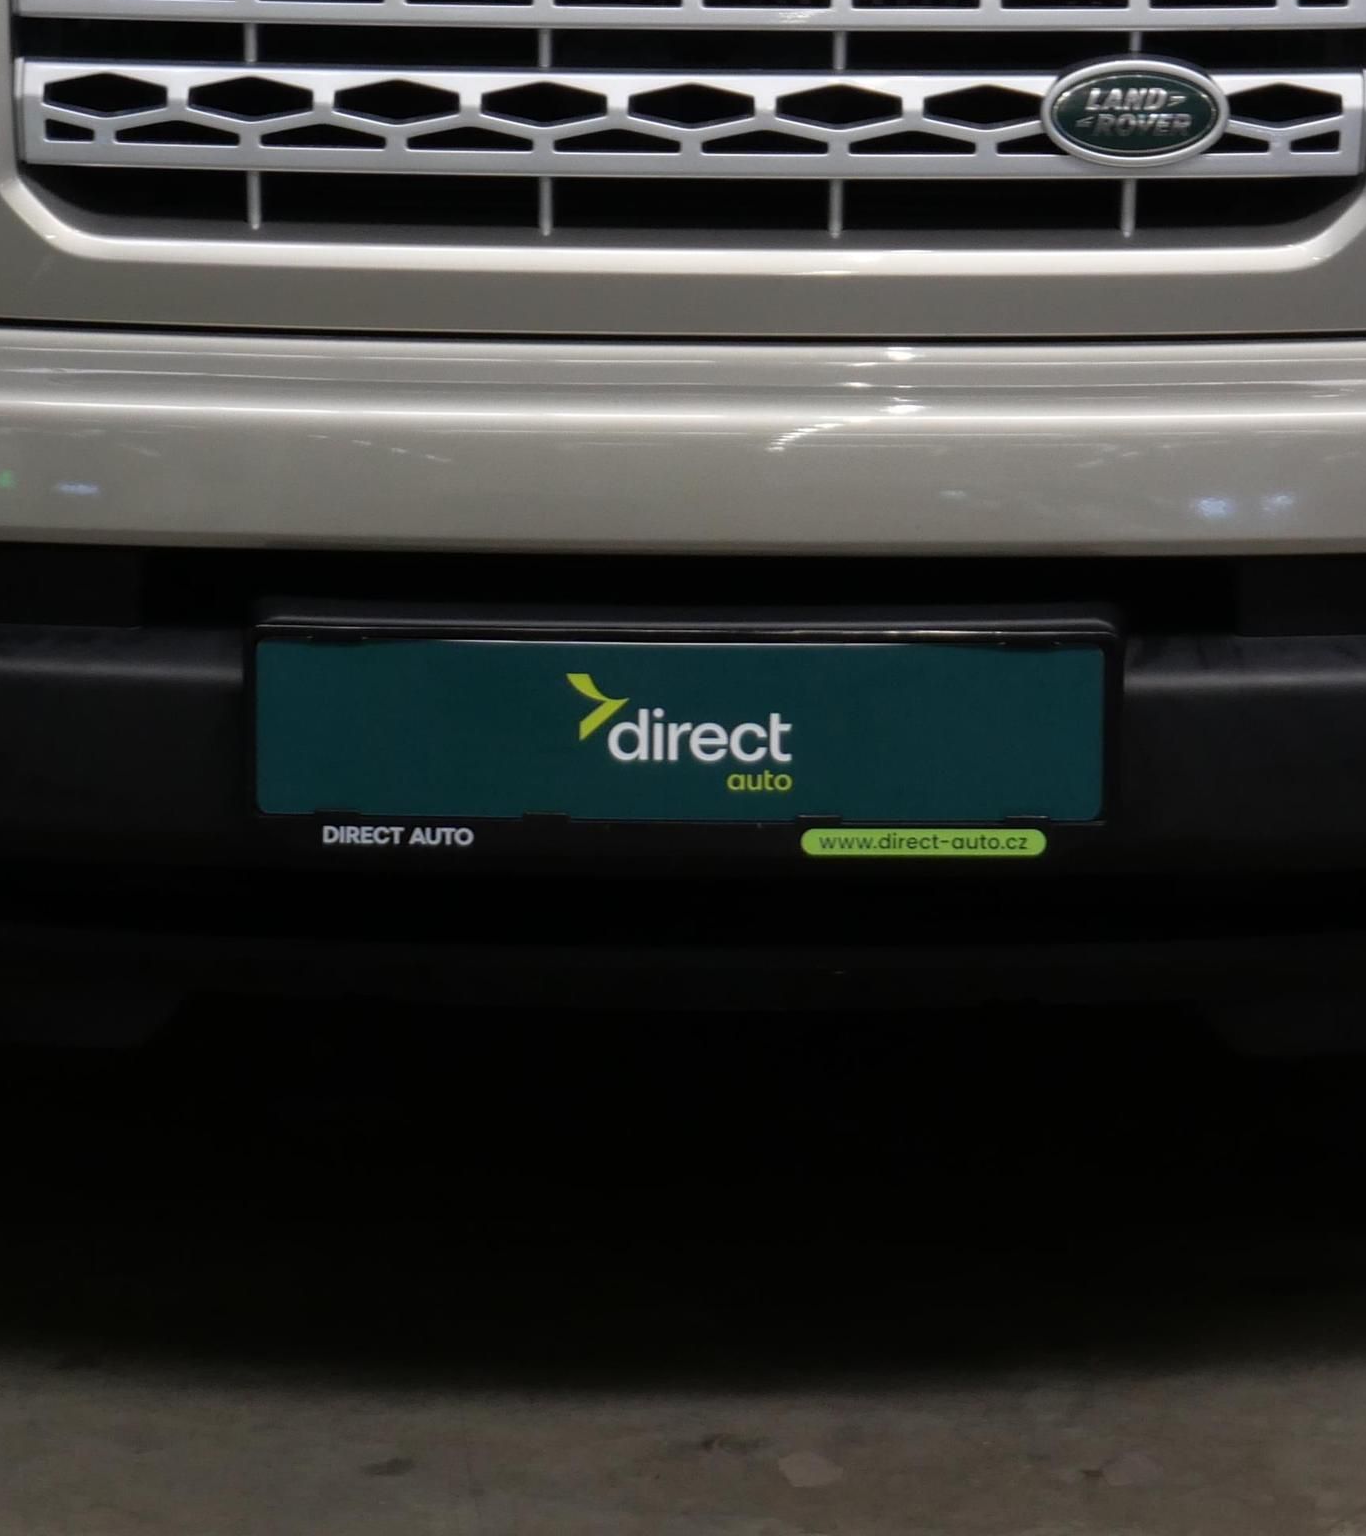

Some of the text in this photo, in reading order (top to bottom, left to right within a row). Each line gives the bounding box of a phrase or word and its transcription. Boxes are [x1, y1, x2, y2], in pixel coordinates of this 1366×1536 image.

[1085, 87, 1168, 111] LAND
[1091, 113, 1193, 137] ROVER
[608, 707, 793, 762] direct
[726, 769, 793, 791] auto
[322, 825, 475, 846] DIRECT AUTO
[818, 832, 1028, 850] www.direct-auto.cz
